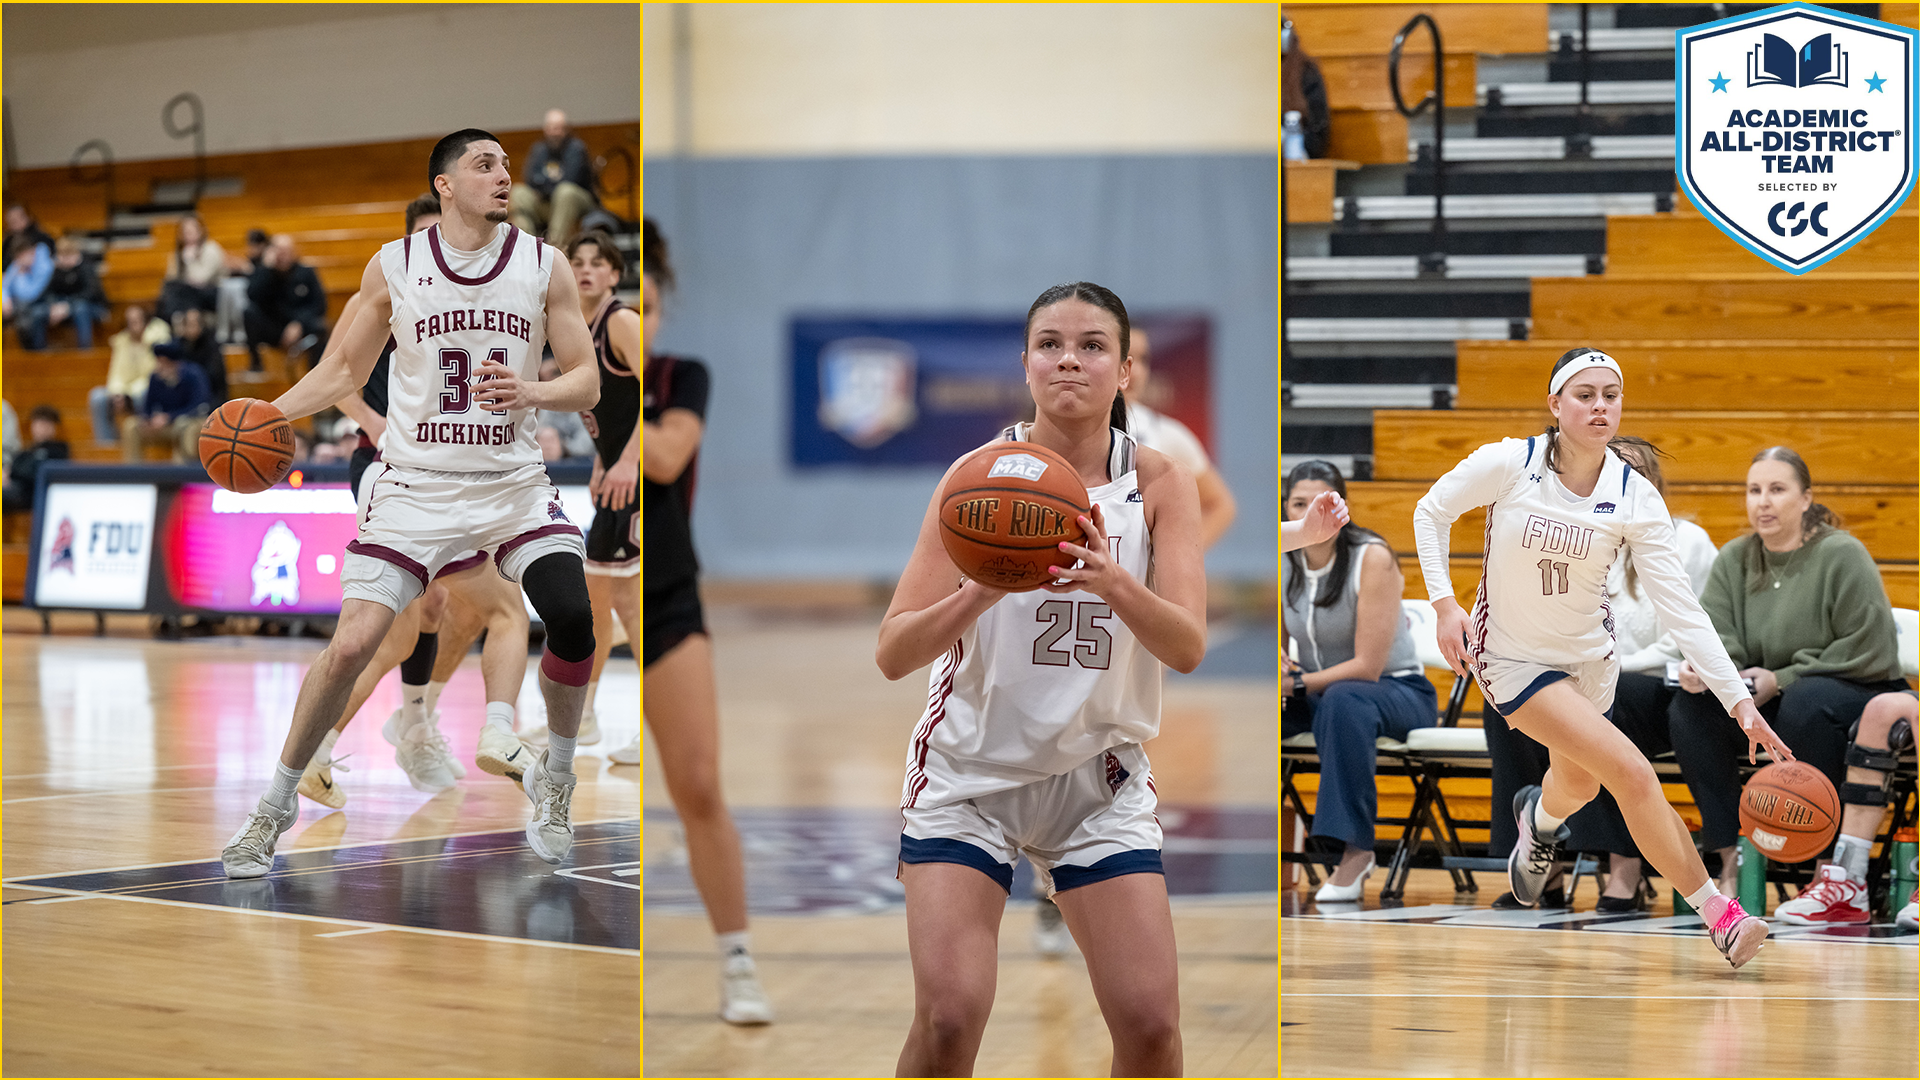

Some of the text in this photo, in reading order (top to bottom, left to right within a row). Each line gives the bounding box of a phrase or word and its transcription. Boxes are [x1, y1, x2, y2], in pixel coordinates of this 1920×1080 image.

[414, 309, 531, 344] FAIRLEIGH
[416, 422, 516, 446] DICKINSON
[992, 463, 1041, 478] MAC
[955, 498, 1069, 538] THE ROCK
[89, 520, 144, 554] FDU
[1522, 514, 1595, 560] FDU
[1537, 559, 1569, 596] 11
[1032, 600, 1113, 671] 25
[1780, 799, 1814, 826] THE
